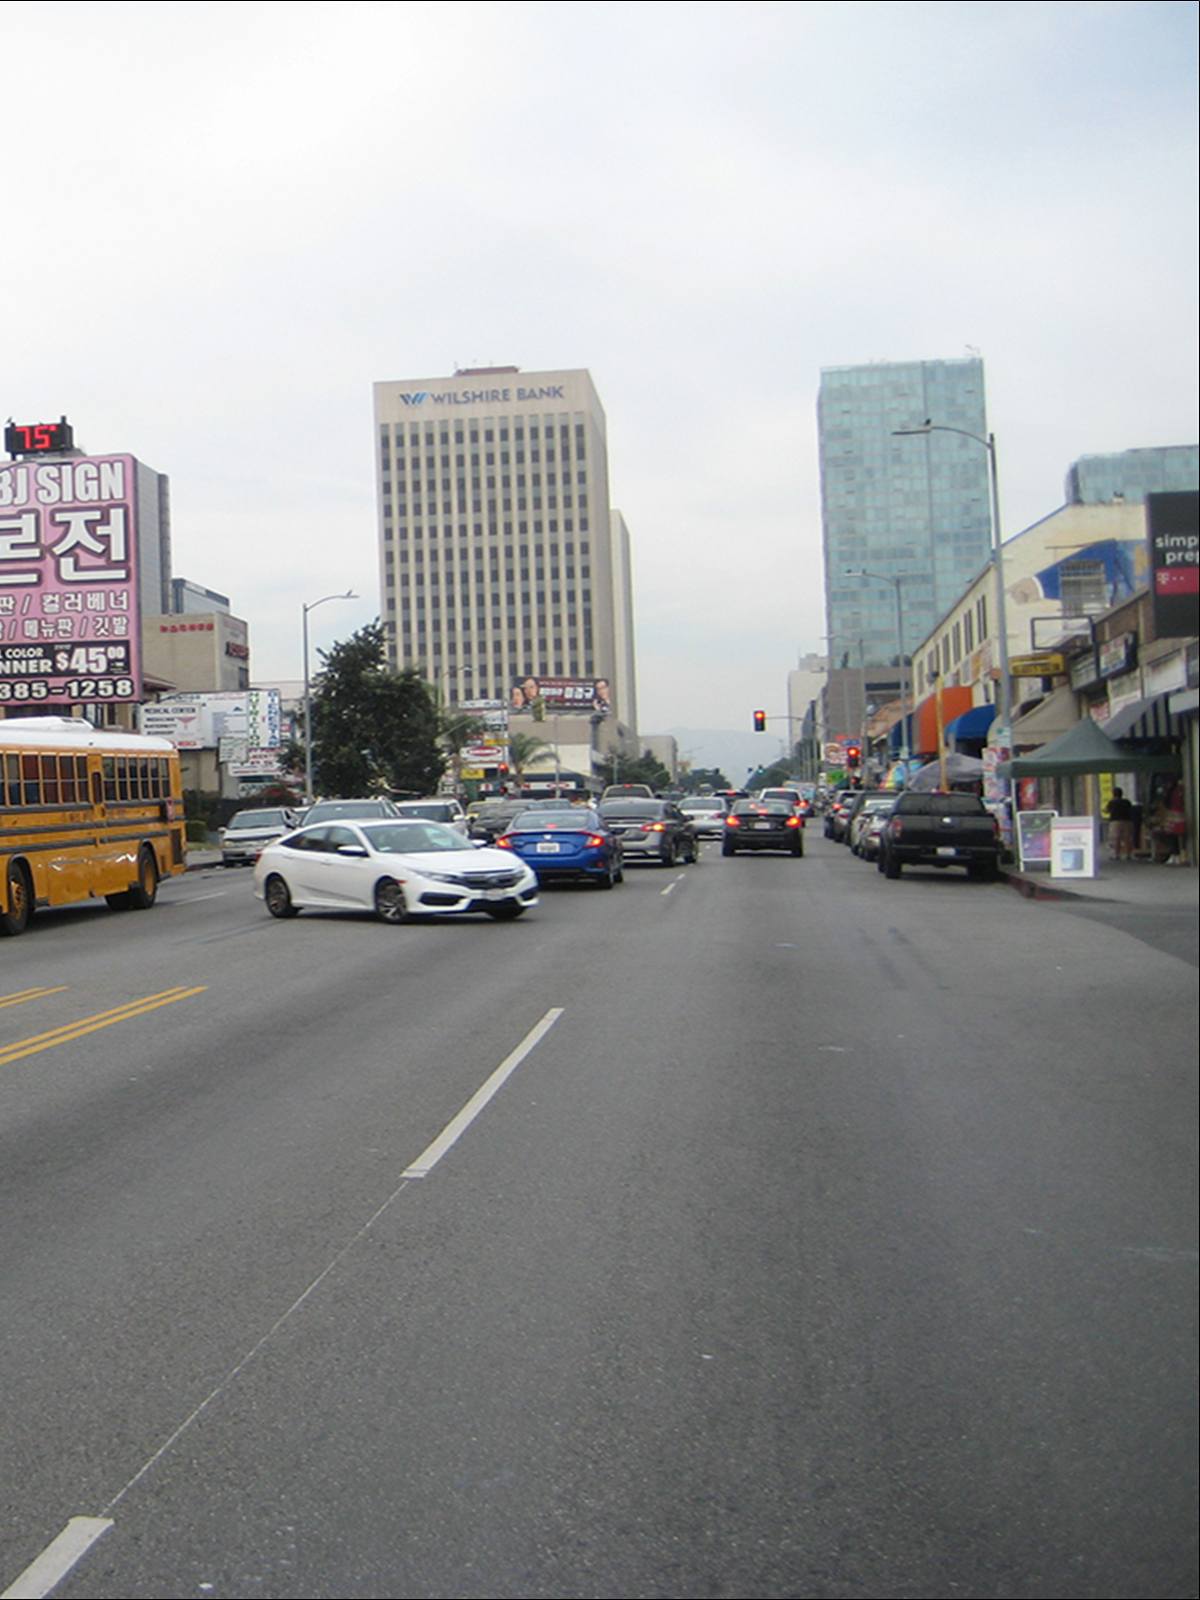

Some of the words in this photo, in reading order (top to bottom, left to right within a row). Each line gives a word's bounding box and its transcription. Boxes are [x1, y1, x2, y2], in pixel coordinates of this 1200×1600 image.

[430, 388, 511, 405] WILSHIRE
[516, 385, 565, 402] BANK
[36, 462, 126, 505] SIGN
[1155, 533, 1199, 549] simp
[5, 647, 45, 660] COLOR
